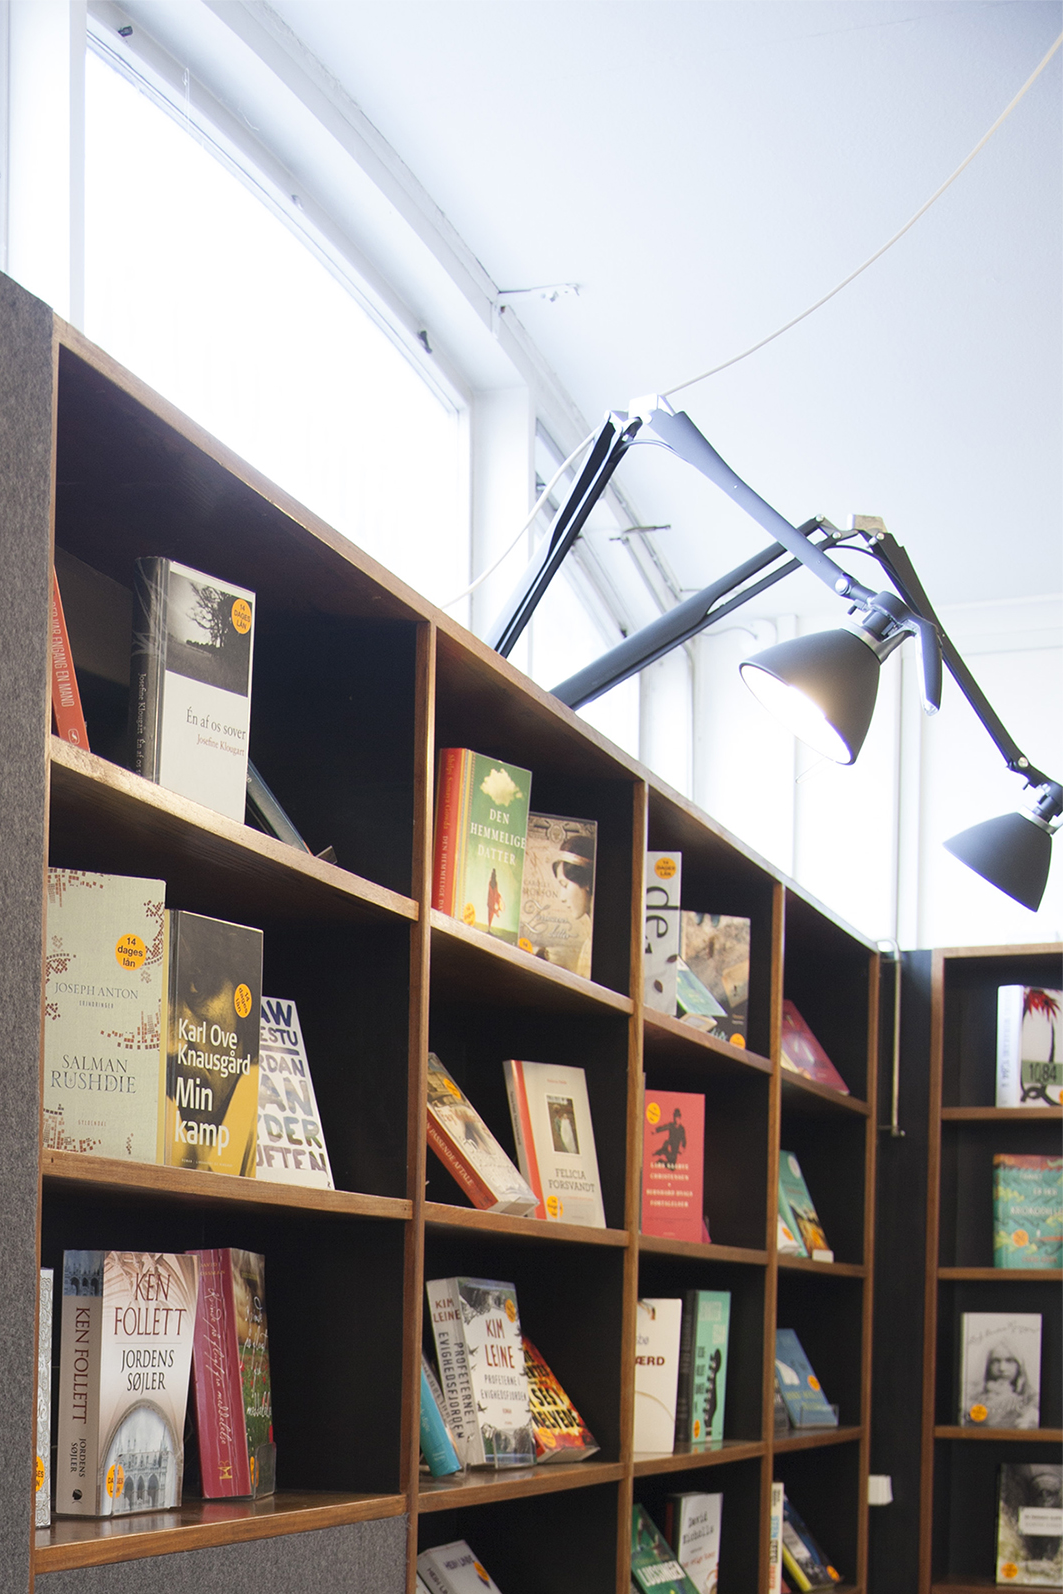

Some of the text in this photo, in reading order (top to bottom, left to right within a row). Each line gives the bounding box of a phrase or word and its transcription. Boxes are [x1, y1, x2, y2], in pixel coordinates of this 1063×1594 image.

[234, 609, 251, 623] DAGES
[52, 636, 67, 670] ENGANG
[57, 670, 69, 682] EN
[58, 683, 75, 708] MAND
[186, 706, 247, 740] Én af os sover
[197, 733, 245, 756] Josefine Klougart
[489, 808, 510, 825] DEN
[441, 835, 449, 850] DEN
[470, 821, 527, 850] HEMMELIGE
[477, 846, 517, 866] DATTER
[439, 853, 448, 898] HEMMELIGE
[117, 945, 144, 958] dages
[127, 937, 136, 946] 14
[122, 957, 136, 968] lån
[54, 982, 139, 1000] JOSEPH ANTON
[178, 1018, 238, 1050] Karl Ove
[62, 1054, 128, 1073] SALMAN
[177, 1043, 251, 1078] Knausgård
[1029, 1061, 1057, 1082] 1Q84
[50, 1070, 137, 1094] RUSHDIE
[175, 1076, 213, 1111] Min
[174, 1110, 231, 1156] kamp
[257, 1113, 323, 1149] DER
[429, 1128, 474, 1186] PASSENDE AFTALE
[548, 1178, 596, 1193] FORSVANDT
[555, 1167, 587, 1181] FELICIA
[135, 1272, 171, 1302] KEN
[434, 1298, 454, 1309] KIM
[114, 1307, 187, 1336] FOLLETT
[433, 1309, 461, 1323] LEINE
[485, 1318, 505, 1339] KIM
[72, 1306, 90, 1424] KEN FOLLETT
[121, 1349, 175, 1373] JORDENS
[484, 1344, 515, 1369] LEINE
[635, 1355, 665, 1366] ÆRD
[127, 1371, 166, 1396] SØJLER
[438, 1332, 464, 1439] EVIGHEDSFJORDEN
[454, 1342, 474, 1419] PROFETERNE
[484, 1374, 516, 1386] PROFETERNE
[480, 1389, 527, 1400] EVIGHEDSFJORDEN
[531, 1408, 581, 1429] HELVEDE
[70, 1442, 78, 1473] SØJLER
[78, 1437, 87, 1478] JORDENS
